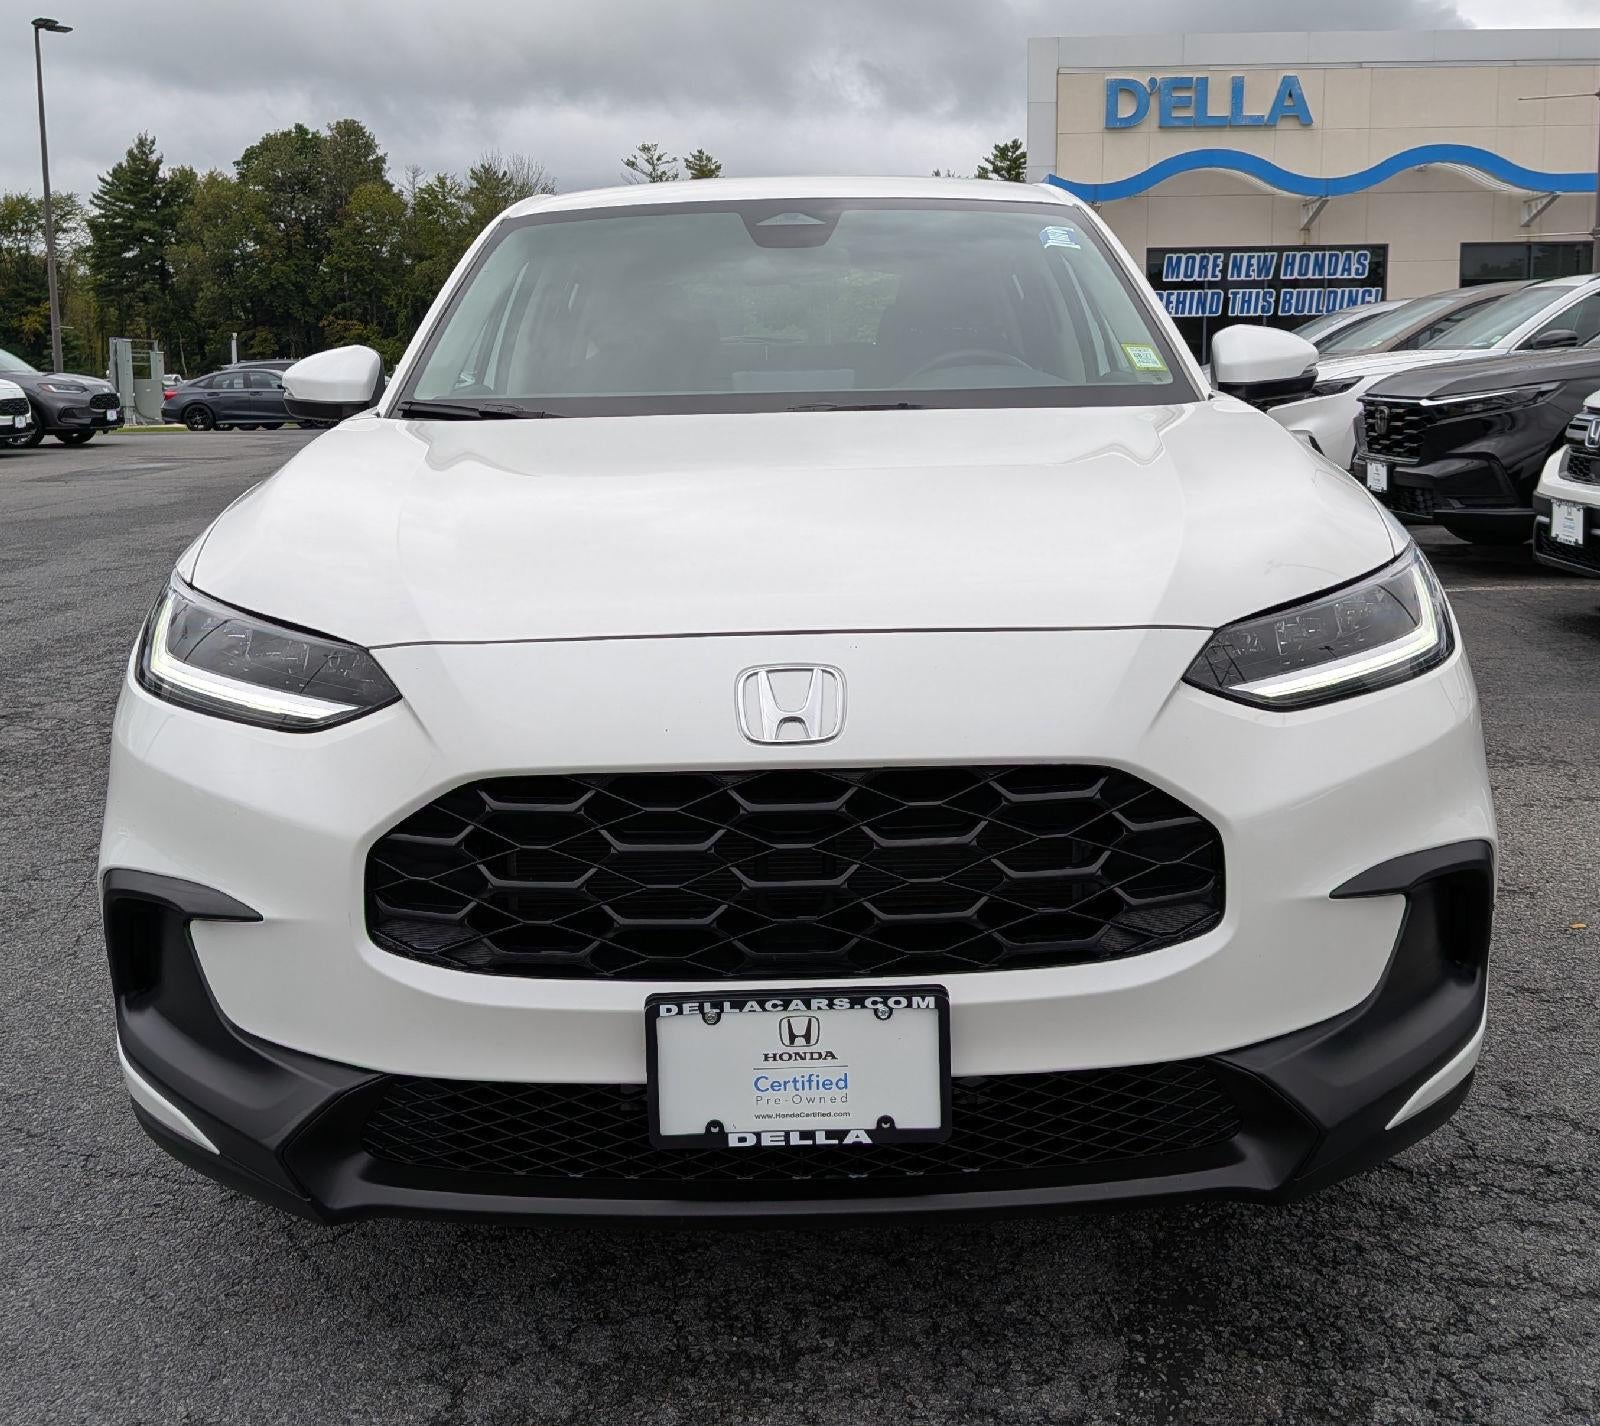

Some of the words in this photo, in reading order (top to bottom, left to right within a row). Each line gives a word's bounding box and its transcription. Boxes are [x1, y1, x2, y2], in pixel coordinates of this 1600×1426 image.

[1163, 253, 1224, 281] MORE
[1227, 252, 1277, 280] NEW
[1280, 250, 1370, 280] HONDAS
[1228, 288, 1275, 316] THIS
[659, 996, 936, 1017] DELLACARS.COM
[762, 1051, 838, 1062] HONDA
[753, 1072, 848, 1093] Certified
[755, 1093, 848, 1106] Pre-Owned
[754, 1111, 850, 1120] www.HondaCertified.com
[728, 1129, 873, 1147] DELLA
